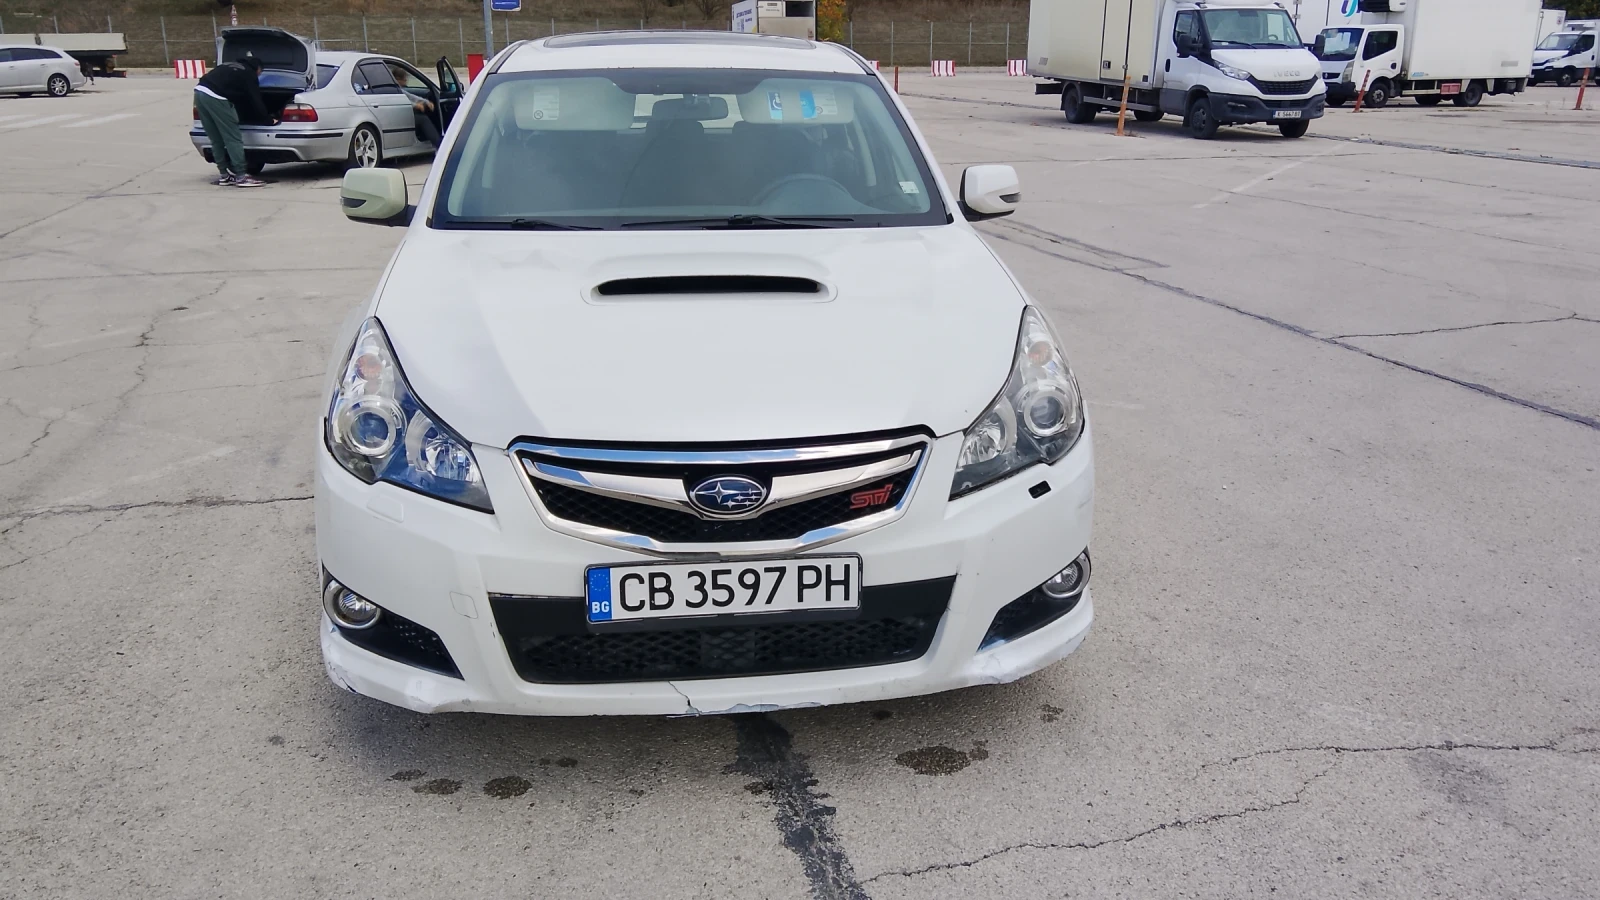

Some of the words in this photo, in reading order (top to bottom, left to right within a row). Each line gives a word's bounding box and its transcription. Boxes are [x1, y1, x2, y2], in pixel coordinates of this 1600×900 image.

[619, 572, 675, 612] CB
[685, 566, 787, 608] 3597
[797, 563, 851, 603] PH
[591, 601, 610, 614] BG
